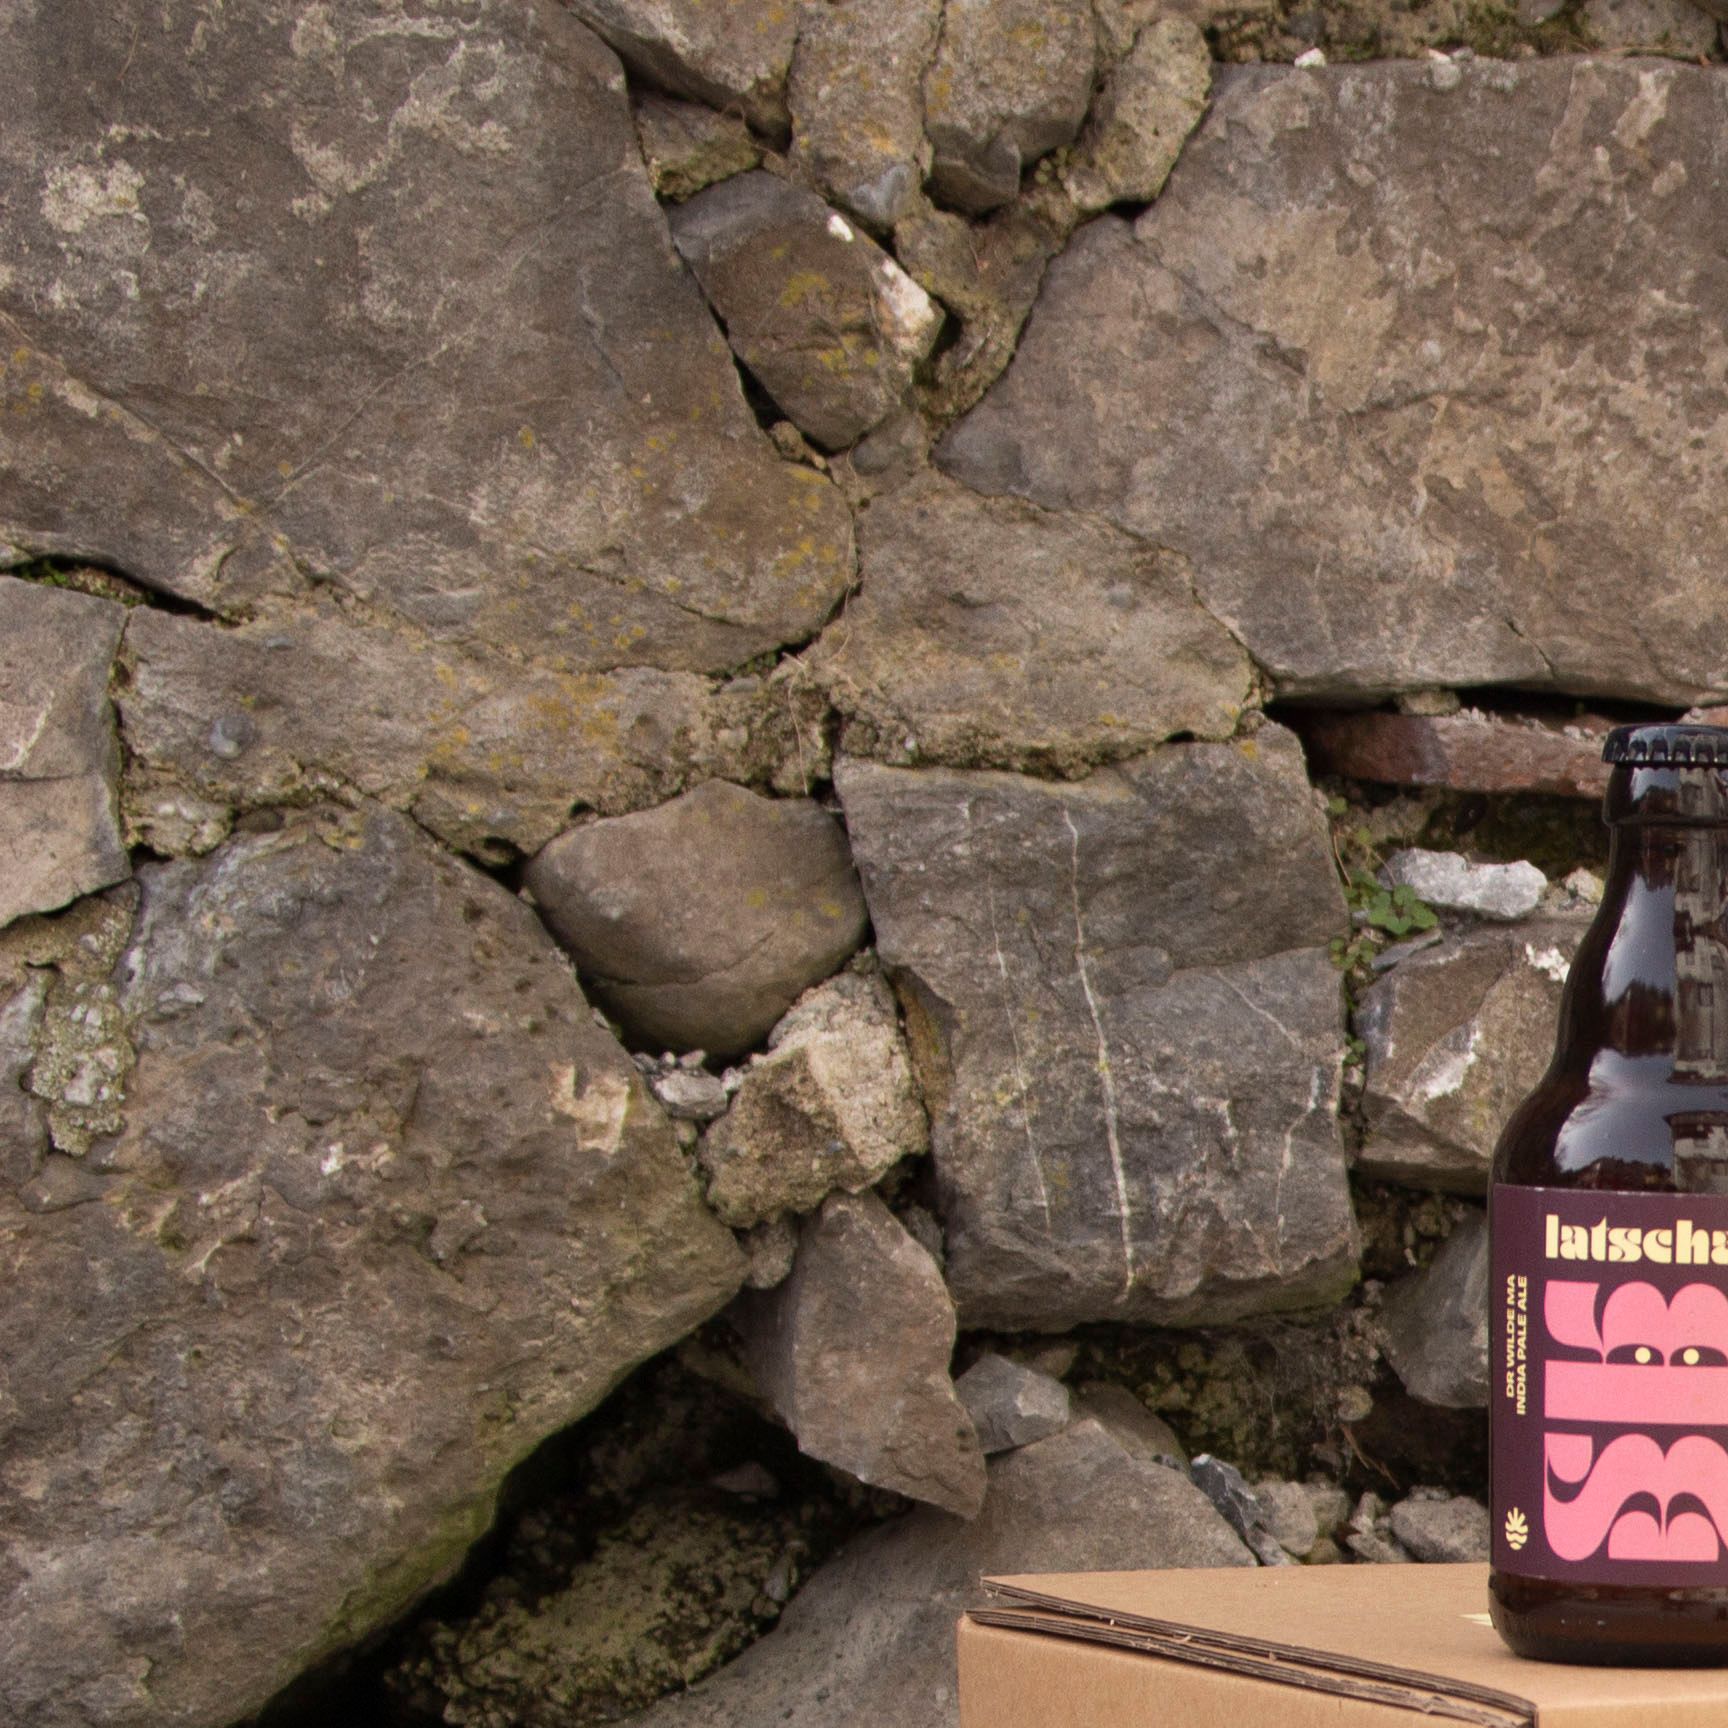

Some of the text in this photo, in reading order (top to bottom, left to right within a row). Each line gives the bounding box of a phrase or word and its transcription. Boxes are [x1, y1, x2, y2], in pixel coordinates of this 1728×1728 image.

[1506, 1274, 1516, 1398] DR WILDE MA
[1516, 1275, 1528, 1415] INDIA PALE ALE
